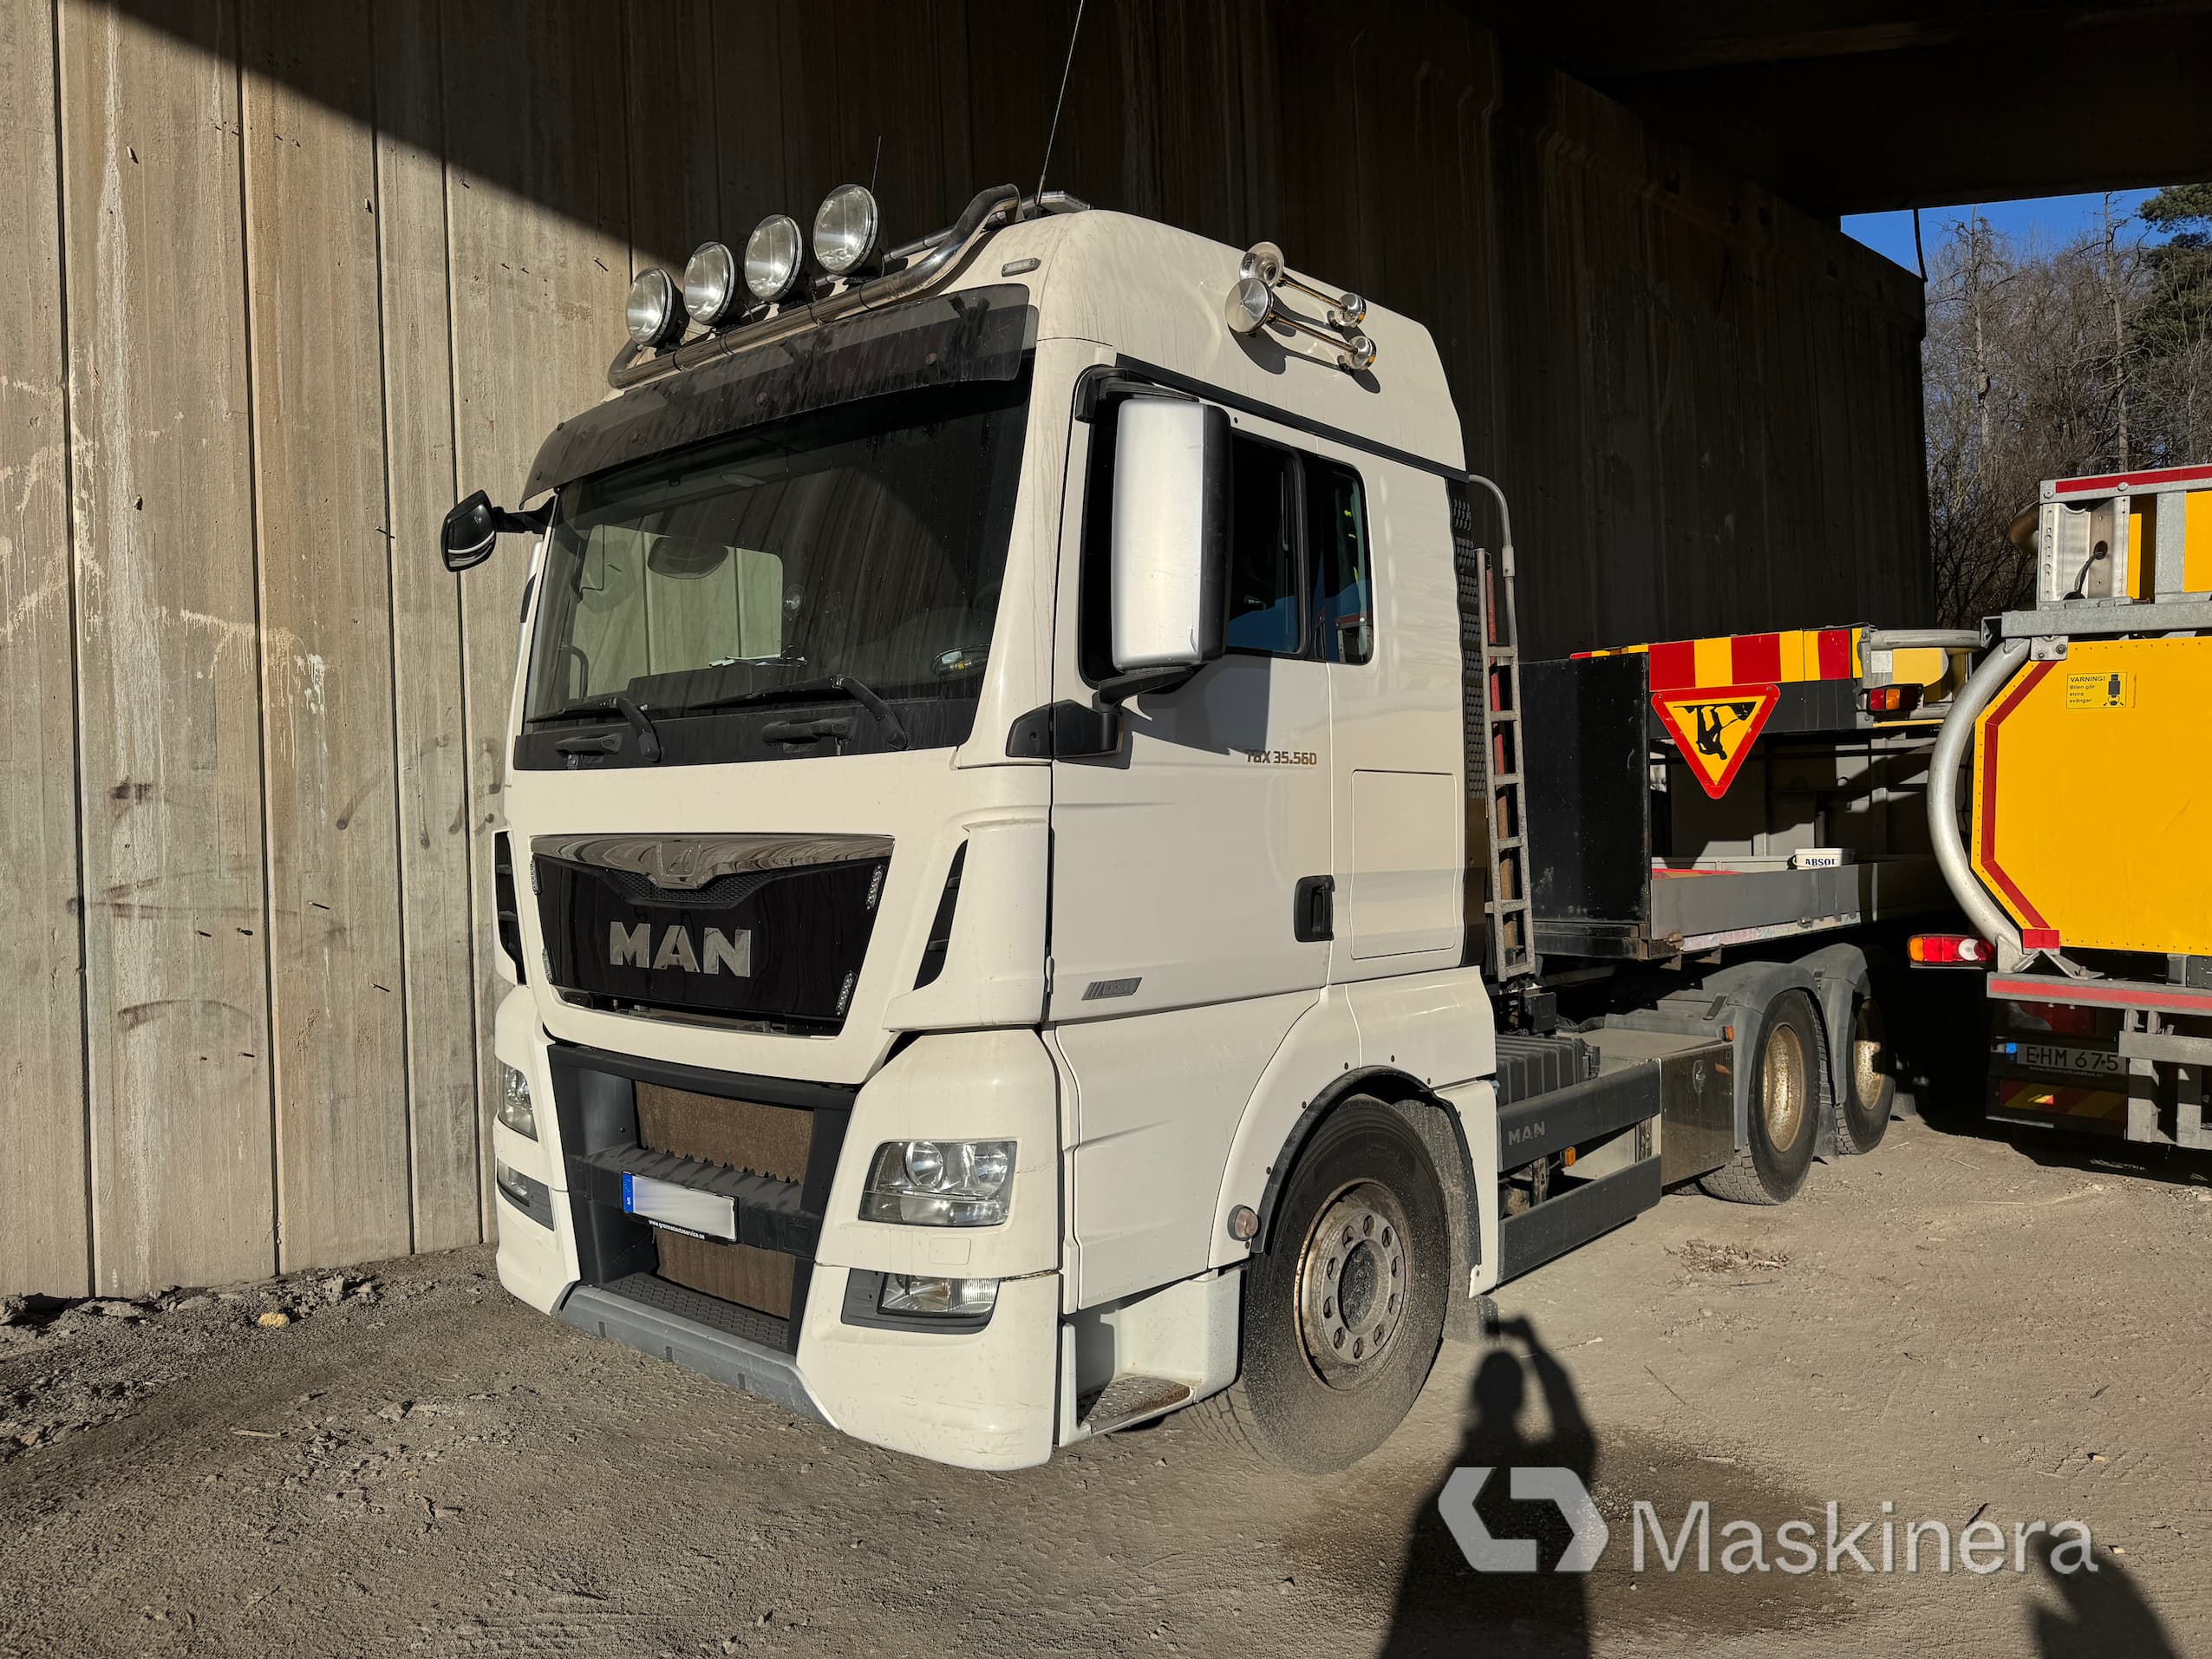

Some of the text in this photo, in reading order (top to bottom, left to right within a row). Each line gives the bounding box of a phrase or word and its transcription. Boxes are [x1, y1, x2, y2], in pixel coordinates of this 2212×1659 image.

[1273, 751, 1317, 765] 35.560
[610, 921, 752, 977] MAN
[2026, 1046, 2119, 1071] EHM 675
[1508, 1120, 1545, 1146] MAN
[626, 1197, 631, 1205] S
